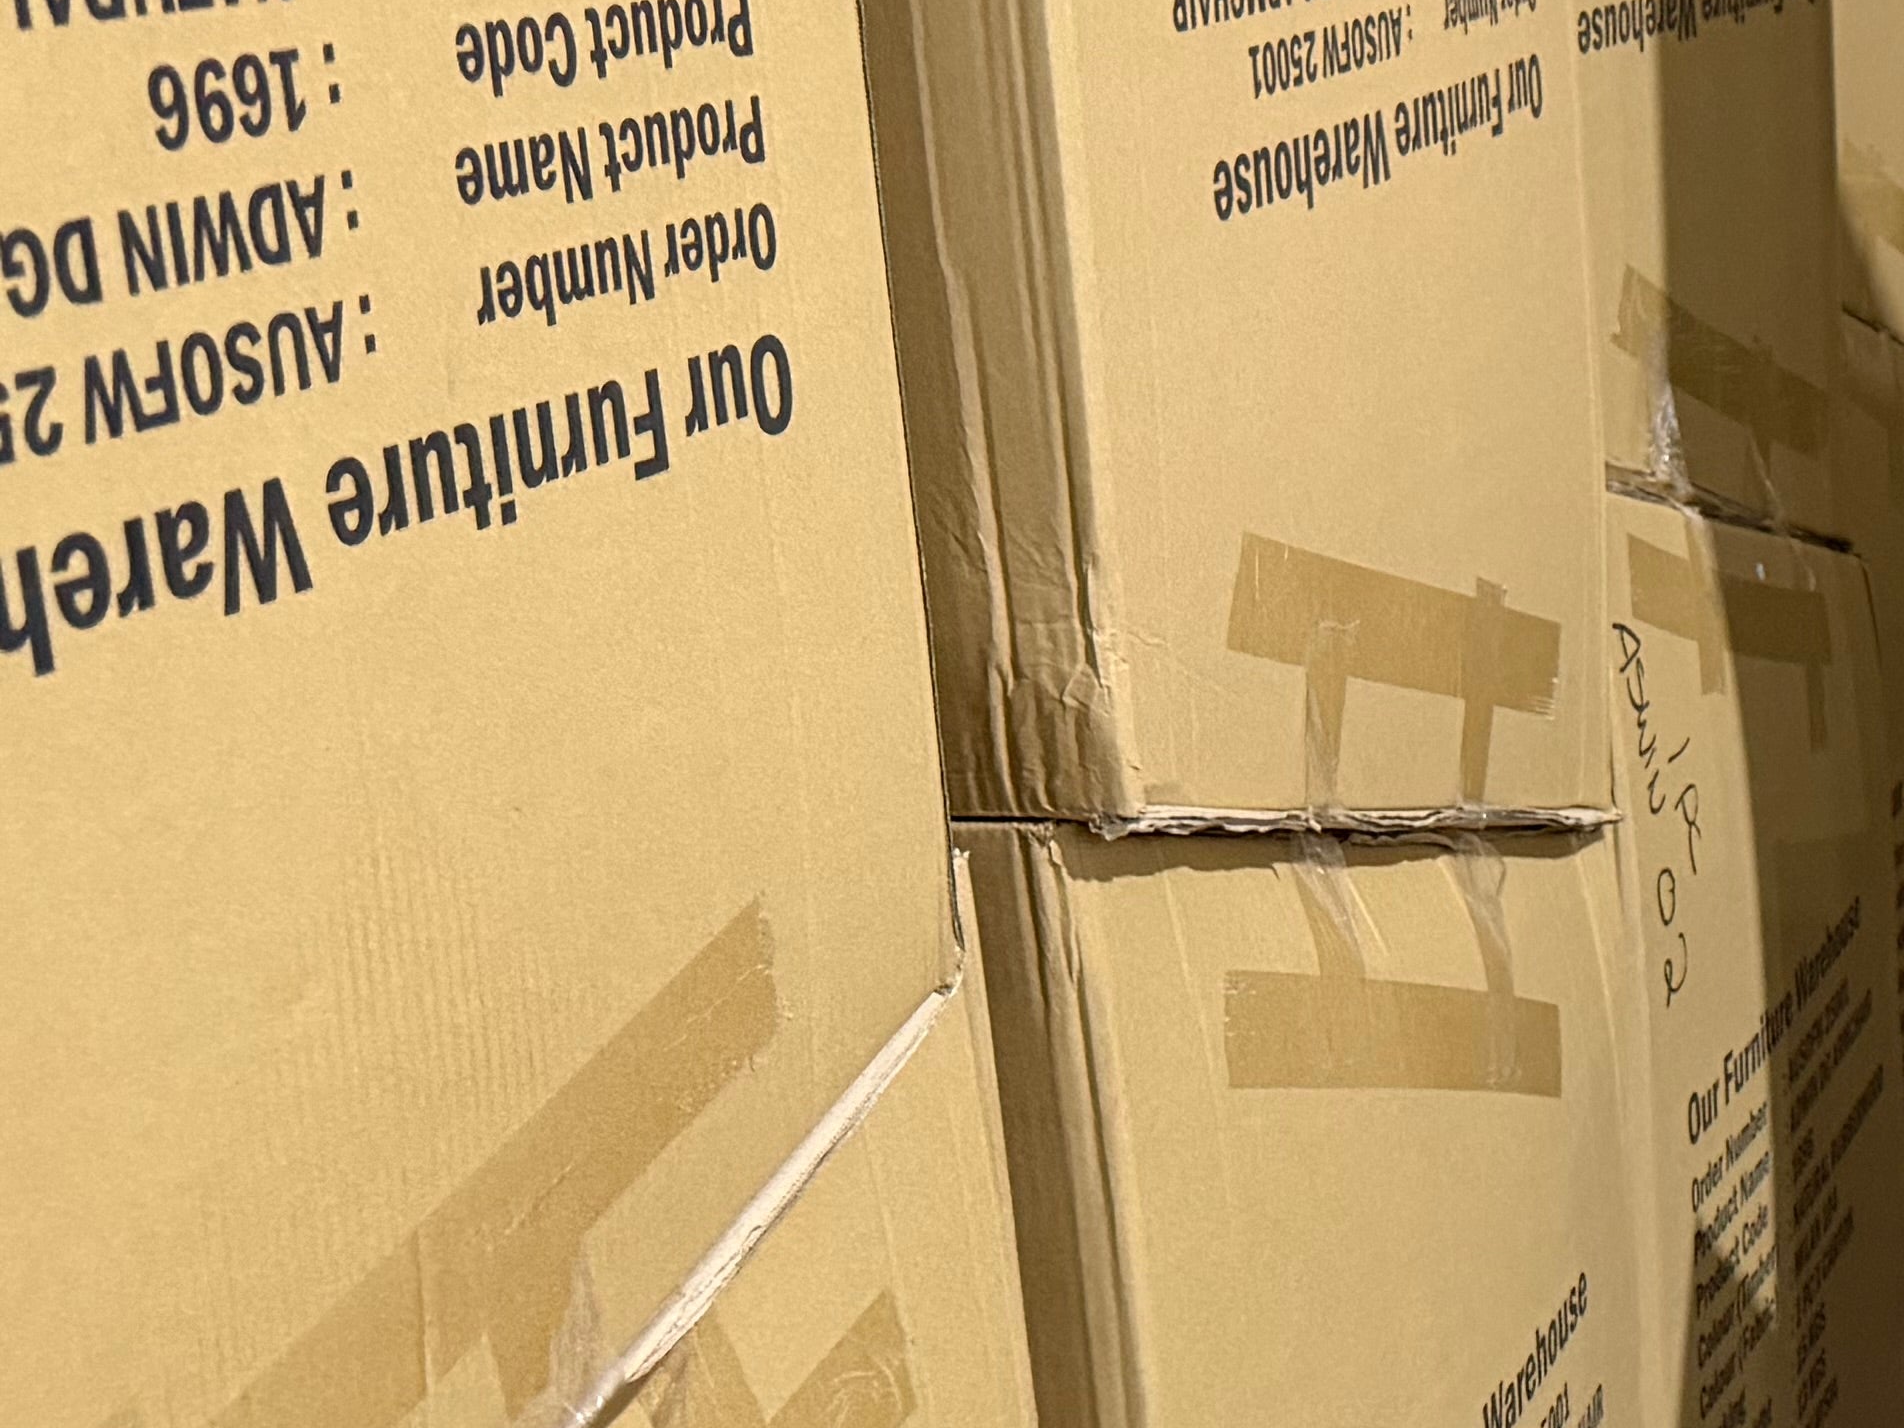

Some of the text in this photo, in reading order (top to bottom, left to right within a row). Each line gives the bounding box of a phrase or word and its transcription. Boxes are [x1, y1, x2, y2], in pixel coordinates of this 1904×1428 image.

[147, 47, 307, 152] 1696
[455, 11, 578, 99] Code
[1247, 6, 1403, 100] AUSOFW 25001
[1212, 53, 1543, 222] Our Furniture Warehouse
[0, 94, 766, 319] Product Name ADWIN DG
[663, 202, 777, 284] Order
[476, 229, 656, 327] Number
[83, 299, 344, 445] AUSOFW
[684, 333, 793, 438] Our
[325, 367, 670, 547] Furniture
[1687, 990, 1794, 1146] Our Furniture
